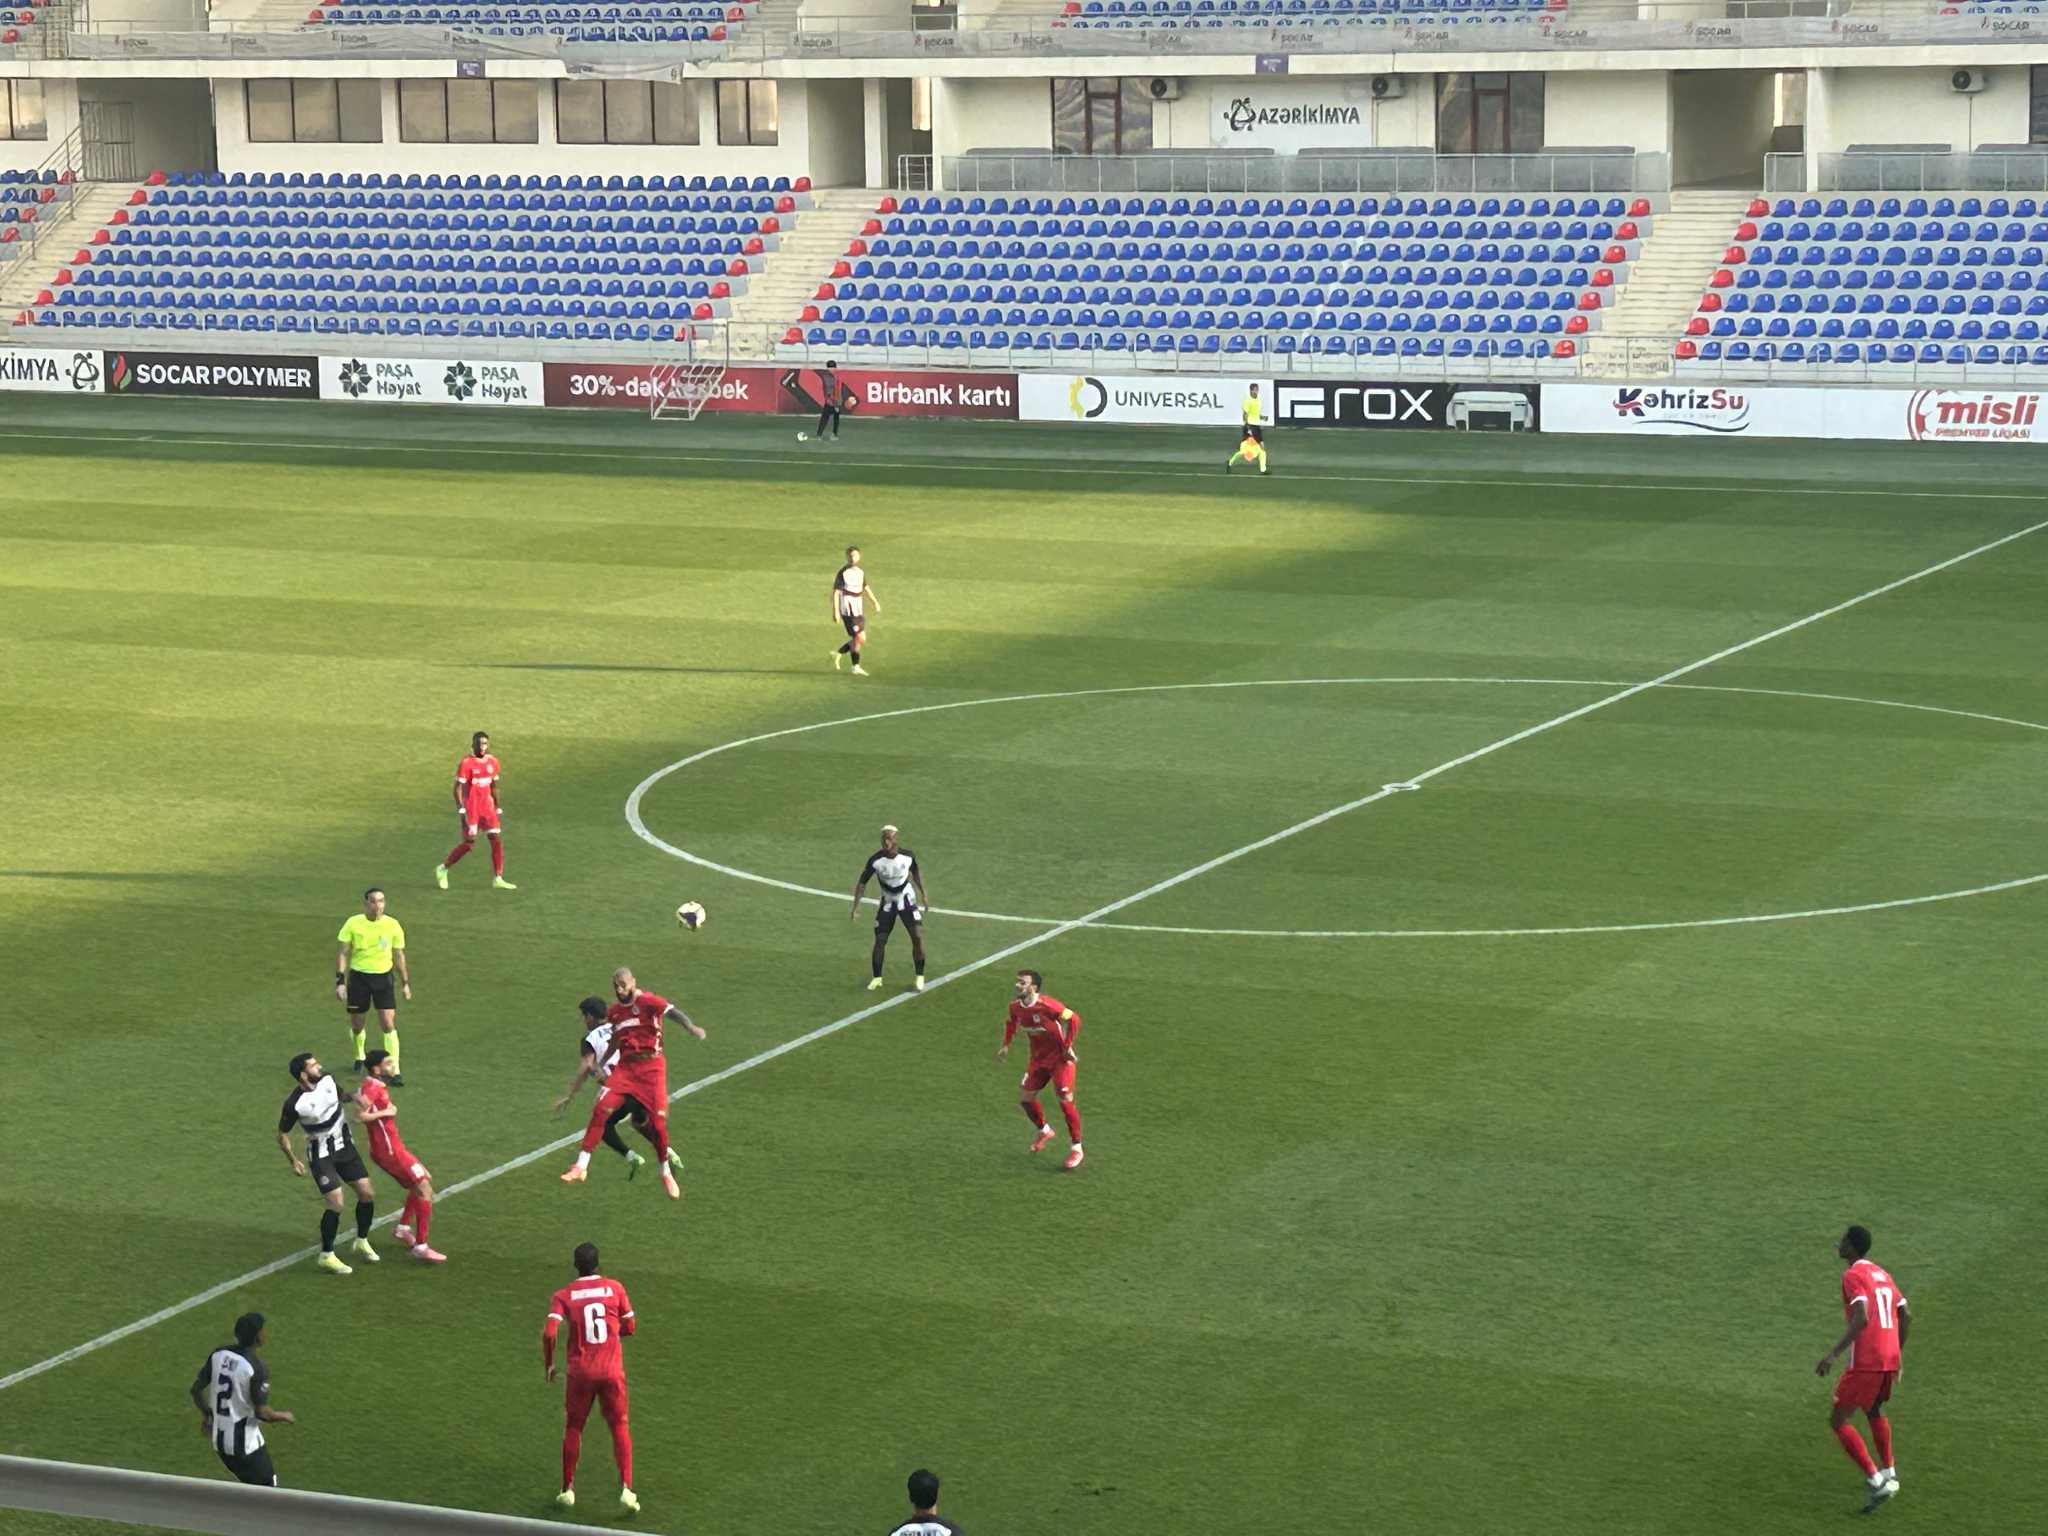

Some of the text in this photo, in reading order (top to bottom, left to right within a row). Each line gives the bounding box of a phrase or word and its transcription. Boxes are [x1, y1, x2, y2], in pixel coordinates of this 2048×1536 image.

[1257, 104, 1360, 124] AZƏRİKİMYA
[866, 382, 1011, 406] Birbank kartı
[1115, 390, 1225, 409] UNIVERSAL
[1936, 394, 2040, 426] misli
[583, 1302, 608, 1344] 6
[216, 1374, 233, 1417] 2
